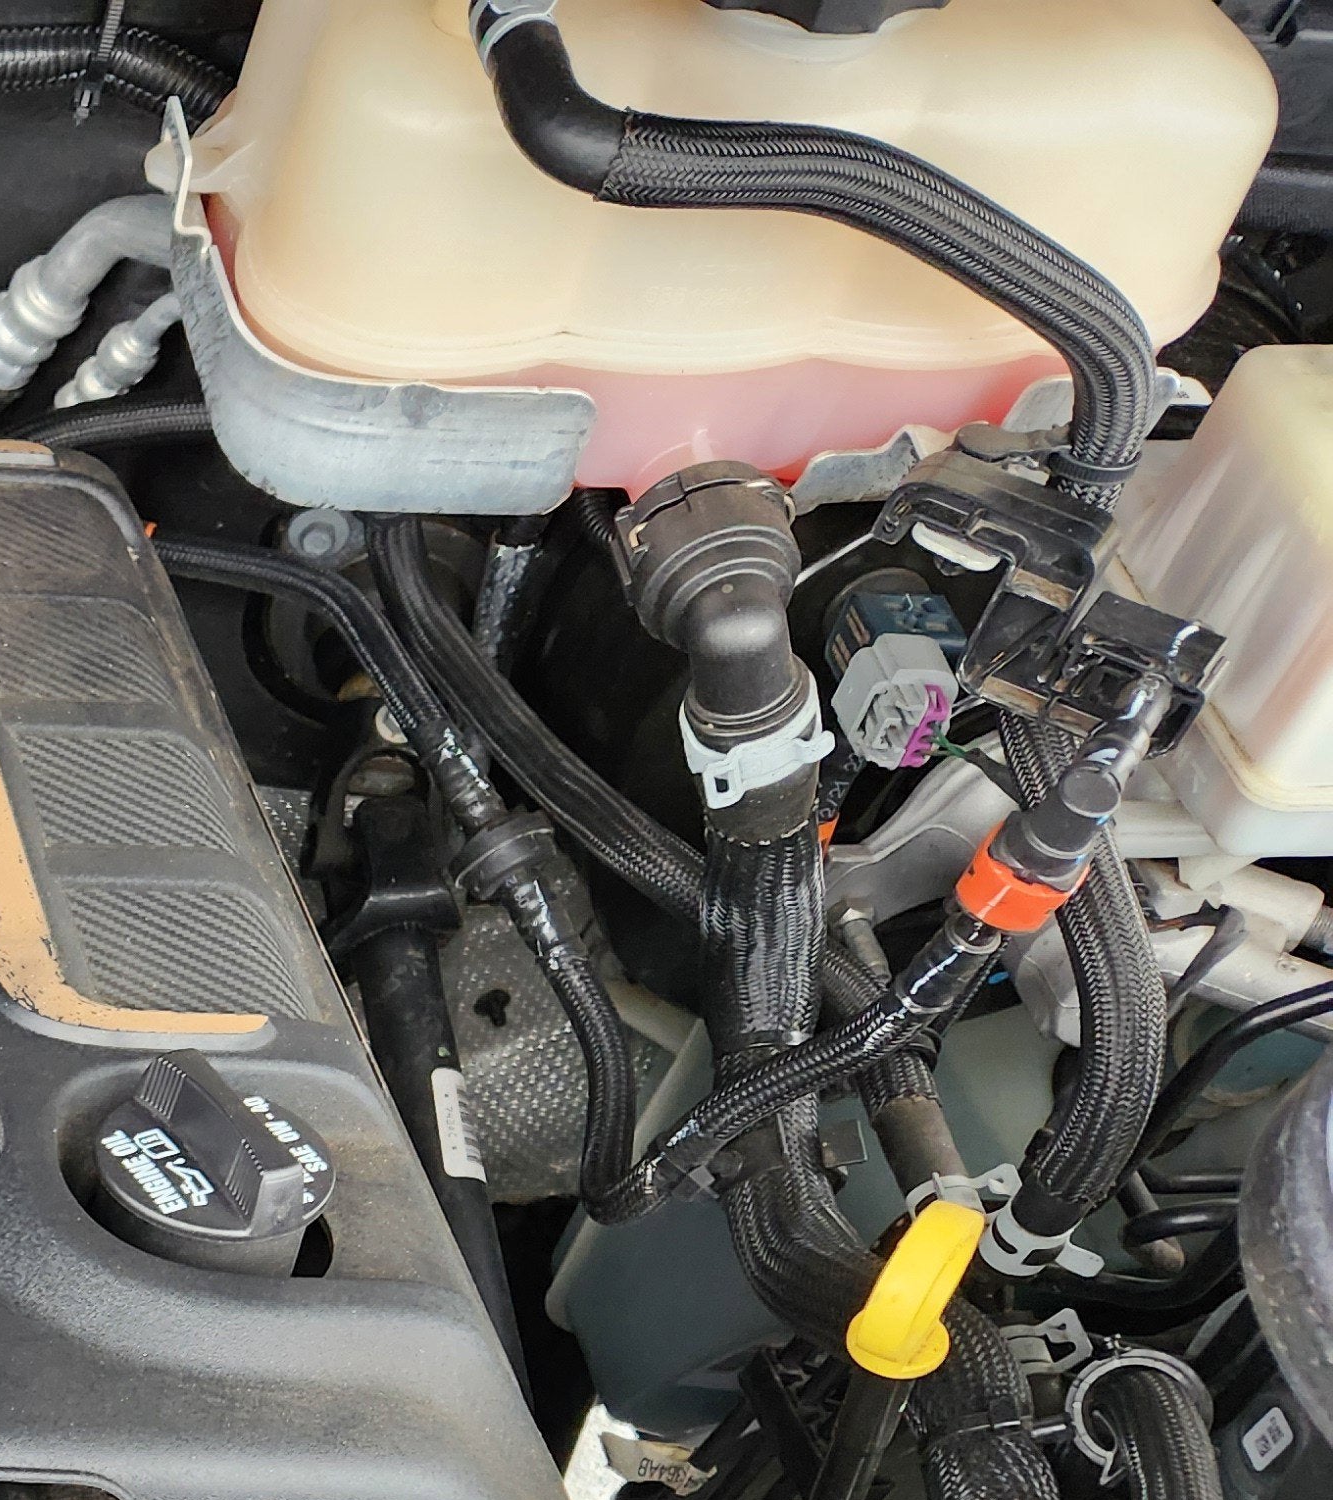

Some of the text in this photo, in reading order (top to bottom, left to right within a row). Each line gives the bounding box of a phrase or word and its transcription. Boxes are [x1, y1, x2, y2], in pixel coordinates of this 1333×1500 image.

[100, 1129, 189, 1215] ENGINE OIL
[289, 1143, 328, 1174] SAE
